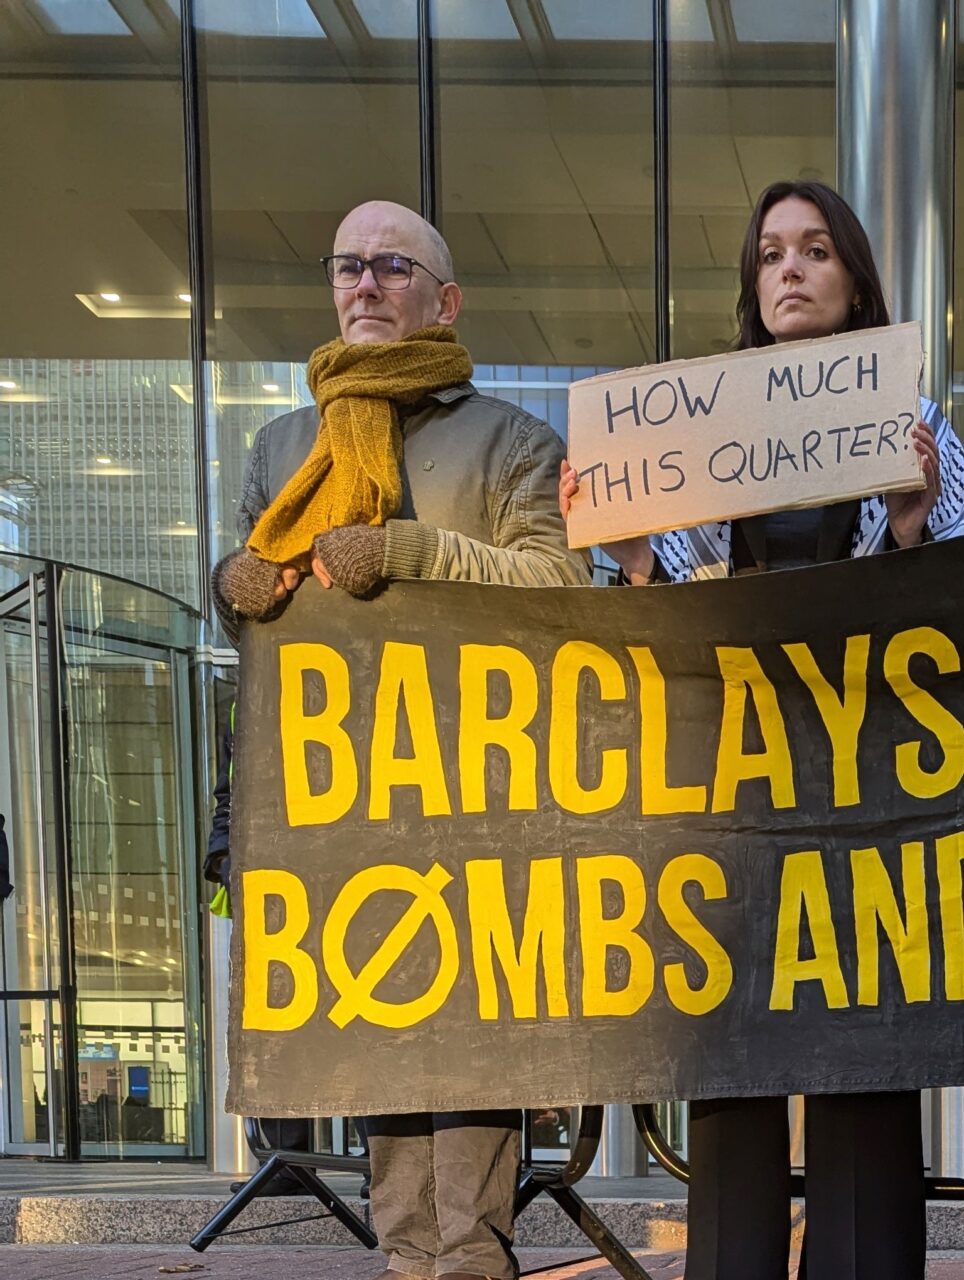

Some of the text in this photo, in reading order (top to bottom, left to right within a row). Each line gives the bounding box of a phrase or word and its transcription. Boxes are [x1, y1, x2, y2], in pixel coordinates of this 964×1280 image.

[604, 351, 880, 434] HOW MUCH
[576, 411, 917, 509] THIS QUARTER?
